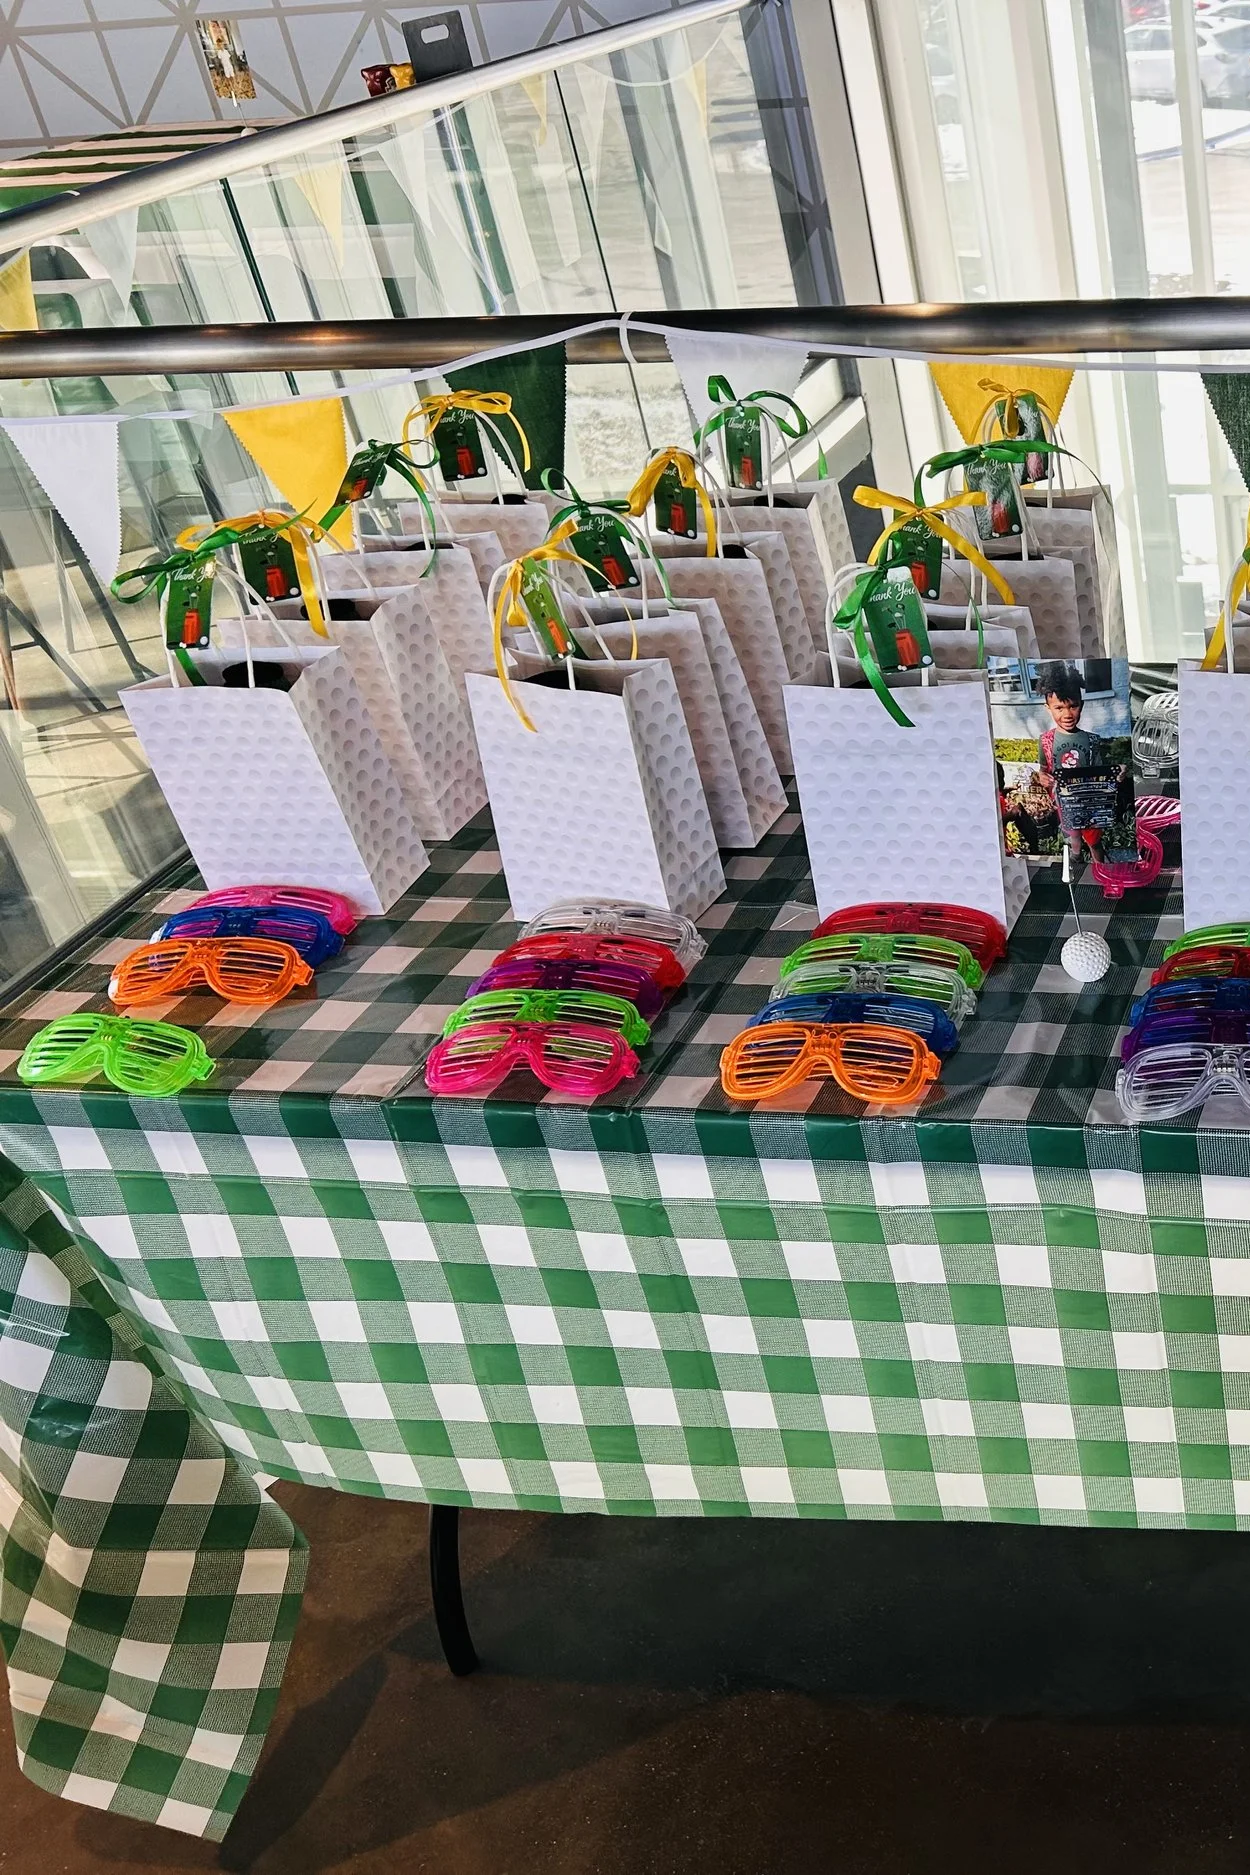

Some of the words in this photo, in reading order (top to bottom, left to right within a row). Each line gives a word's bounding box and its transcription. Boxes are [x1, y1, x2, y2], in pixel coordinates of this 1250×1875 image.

[457, 409, 475, 424] You
[725, 416, 747, 430] Thank
[663, 467, 677, 477] ank
[989, 458, 1007, 475] You
[578, 519, 594, 532] ank
[594, 515, 615, 532] You
[902, 523, 923, 535] hank
[171, 564, 196, 581] Thank
[893, 581, 916, 602] You
